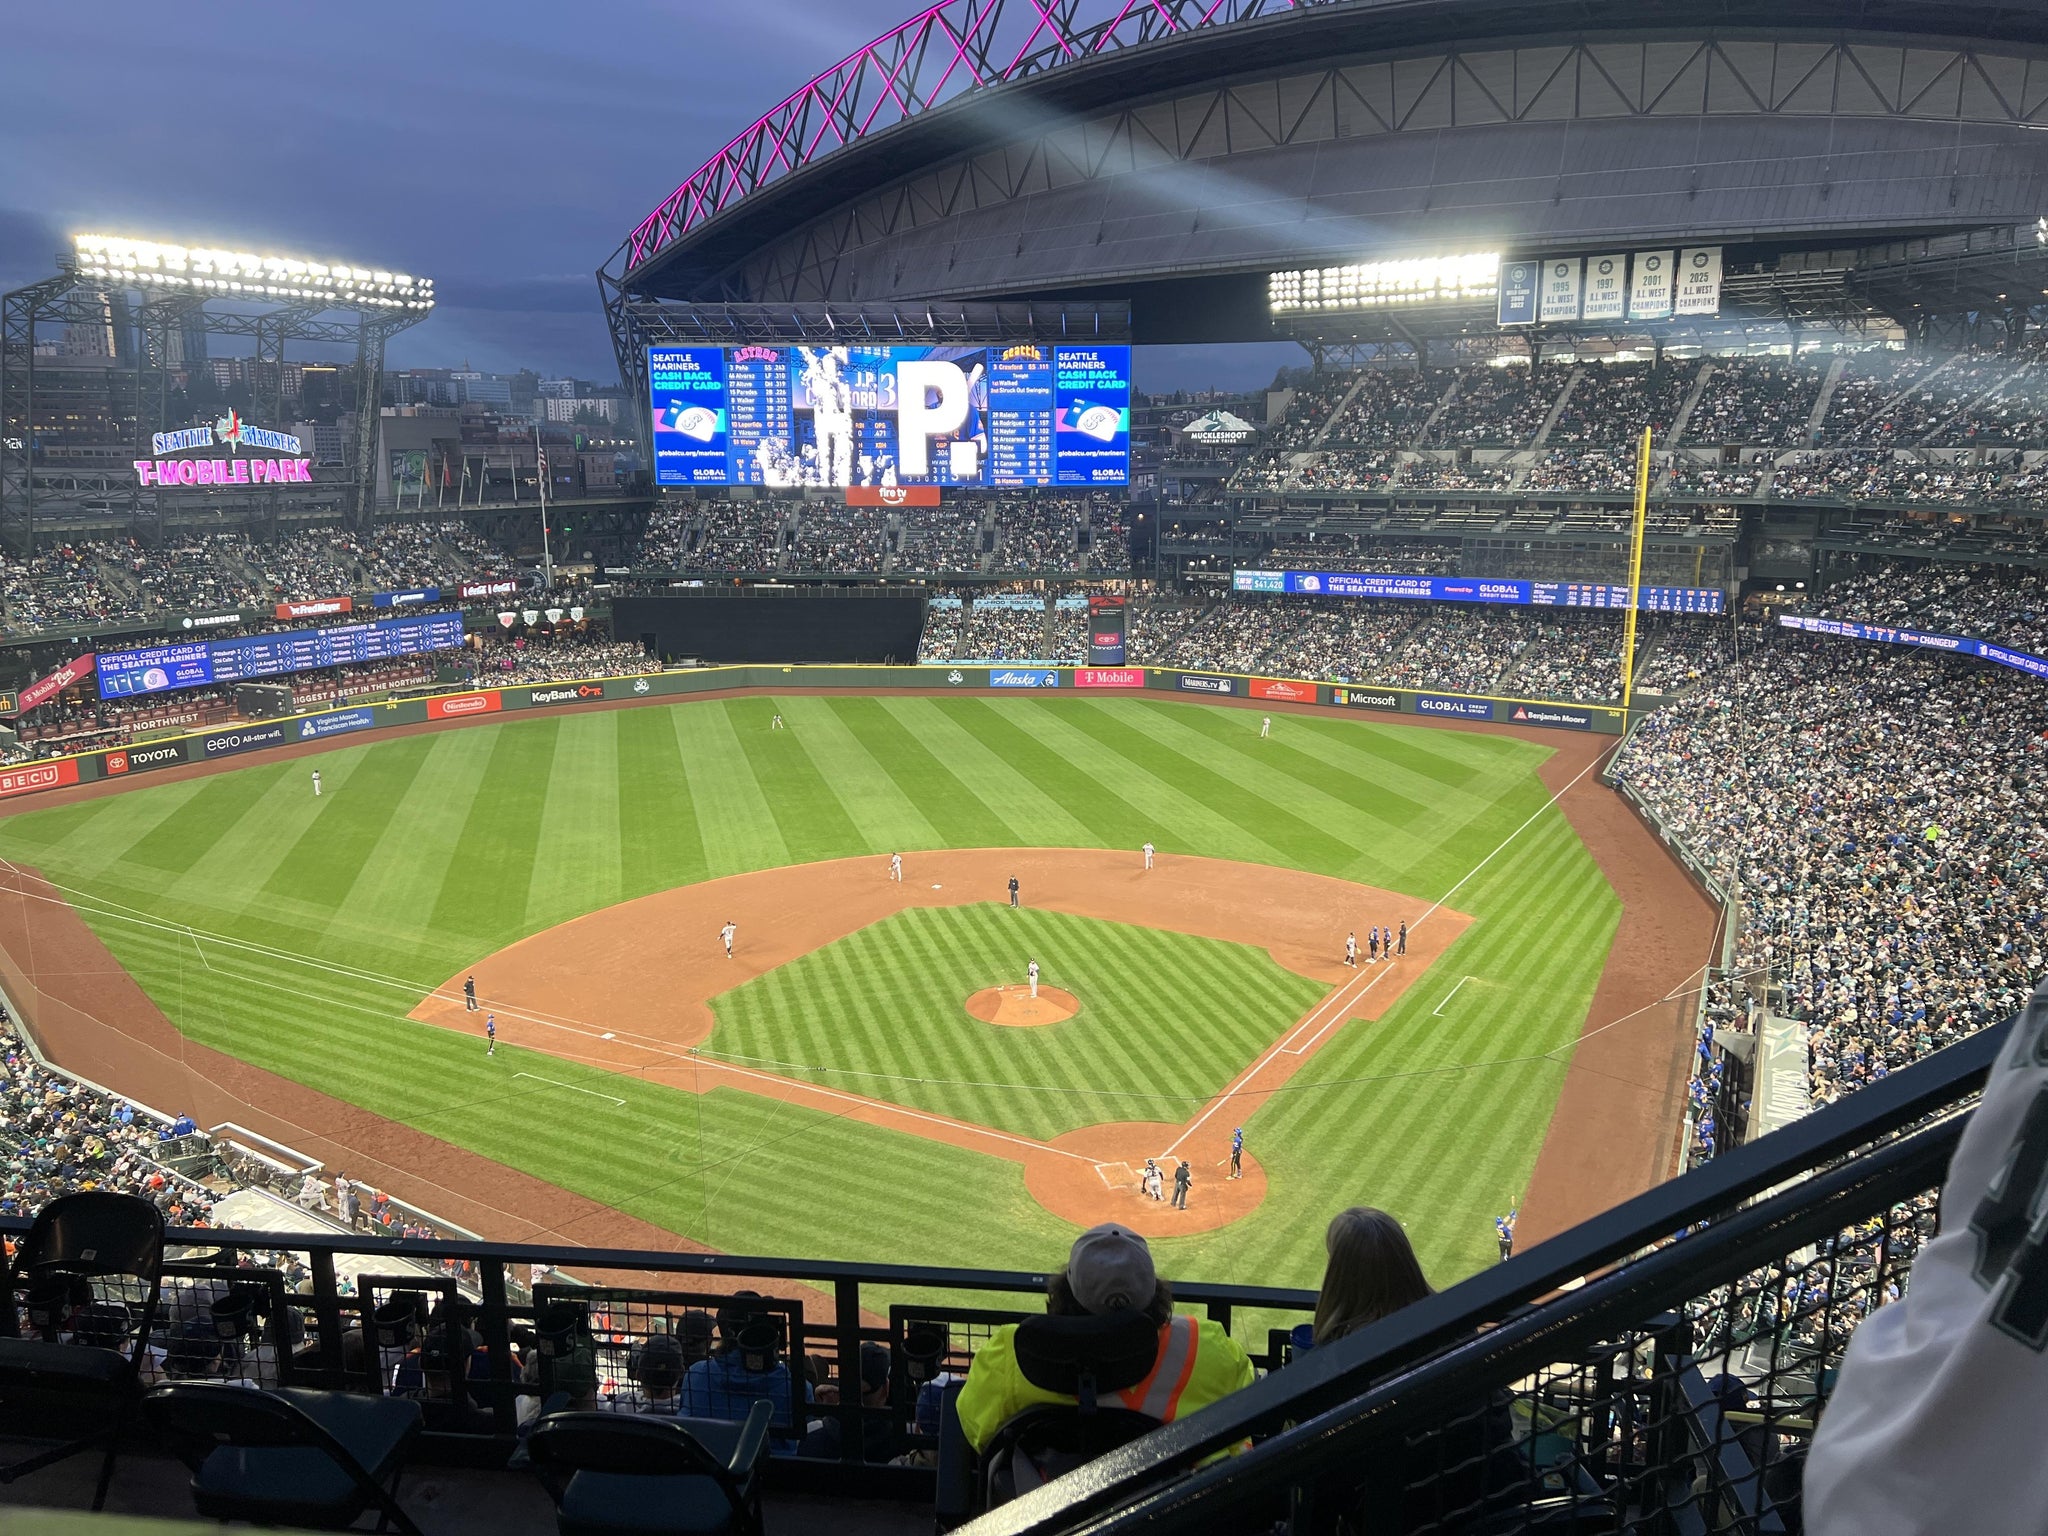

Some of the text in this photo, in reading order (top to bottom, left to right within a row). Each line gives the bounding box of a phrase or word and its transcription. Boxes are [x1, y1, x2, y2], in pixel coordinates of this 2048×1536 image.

[1643, 275, 1661, 285] 2001
[1690, 272, 1709, 282] 2025
[1552, 282, 1570, 292] 1995
[1596, 278, 1613, 289] 1997
[1590, 291, 1617, 301] A.L. WEST
[1649, 289, 1665, 298] WEST
[1684, 285, 1712, 295] A.L. WEST
[1546, 295, 1574, 304] A.L. WEST
[1680, 298, 1715, 309] CHAMPIONS
[1543, 306, 1576, 318] CHAMPIONS
[1586, 303, 1621, 315] CHAMPIONS
[1632, 300, 1668, 312] CHAMPIONS
[654, 372, 681, 380] CASH
[1058, 370, 1117, 379] CASH BACK
[881, 373, 896, 407] 3
[1058, 381, 1126, 389] CREDIT CARD
[897, 361, 977, 475] P.
[153, 425, 301, 455] SEATTLE MARINERS
[134, 459, 312, 486] T-MOBILE PARK
[879, 488, 896, 497] fire
[1365, 578, 1393, 586] CREDIT
[1347, 585, 1384, 593] SEATTLE
[1386, 587, 1431, 595] MARINERS
[1480, 585, 1519, 593] GLOBAL
[194, 615, 240, 626] STARBUCKS
[1900, 633, 1909, 641] 90
[1920, 636, 1959, 648] CHANGEUP
[100, 654, 136, 664] OFFICIAL
[140, 650, 170, 659] CREDIT
[171, 647, 193, 655] CARD
[101, 652, 207, 671] THE SEATTLE MARINERS
[1989, 649, 2046, 672] OFFICIAL CREDIT CARD OF
[176, 668, 204, 676] GLOBAL
[1085, 672, 1133, 682] T Mobile
[32, 682, 56, 699] Mobile
[52, 668, 76, 687] Pen
[993, 672, 1035, 686] Alaska
[338, 687, 359, 697] BEST
[371, 683, 387, 691] THE
[532, 689, 577, 702] KeyBank
[1350, 692, 1395, 706] Microsoft
[447, 701, 482, 710] Nintendo
[1421, 700, 1466, 712] GLOBAL
[134, 713, 198, 731] NORTHWEST
[317, 713, 358, 725] Virginia Mason
[1528, 712, 1586, 723] Benjamin Moore
[318, 718, 369, 732] Franciscan Health
[207, 736, 240, 751] eero
[243, 733, 266, 743] All-star
[131, 748, 178, 764] TOYOTA
